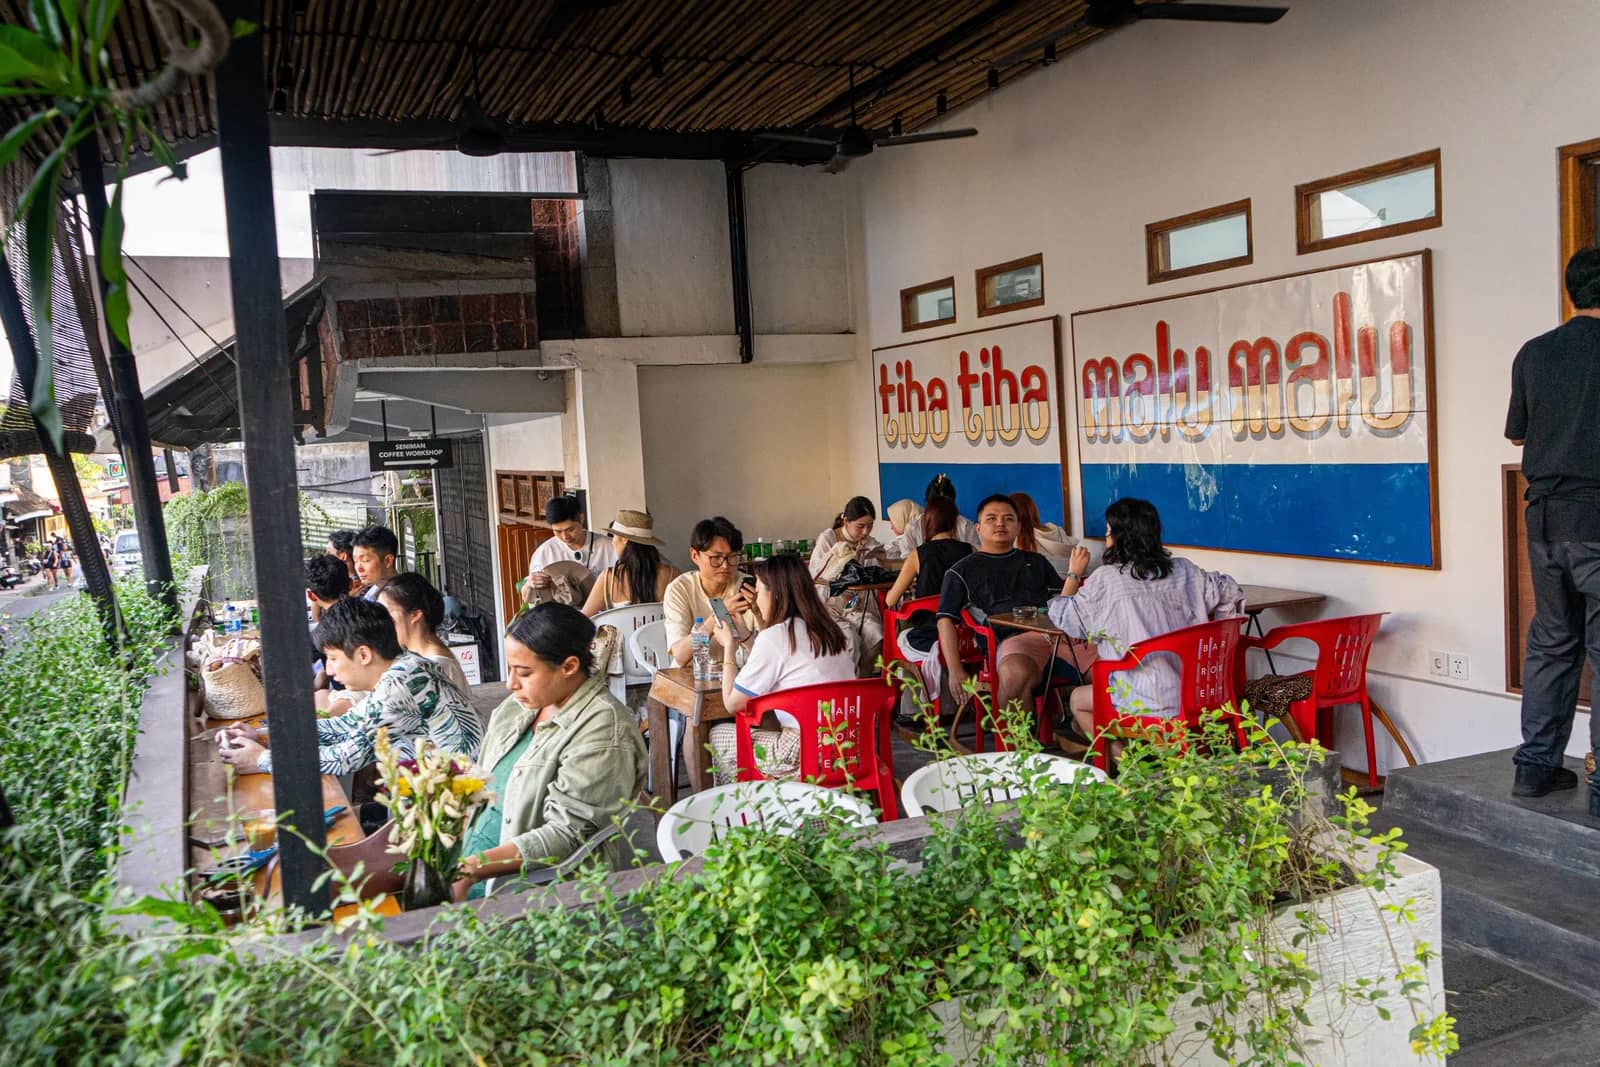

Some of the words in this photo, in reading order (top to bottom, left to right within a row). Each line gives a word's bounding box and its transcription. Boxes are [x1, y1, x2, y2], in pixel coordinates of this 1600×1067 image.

[1082, 320, 1214, 441] malu
[1228, 291, 1412, 438] malu
[395, 442, 426, 450] SENIMAN
[405, 449, 443, 457] WORKSHOP
